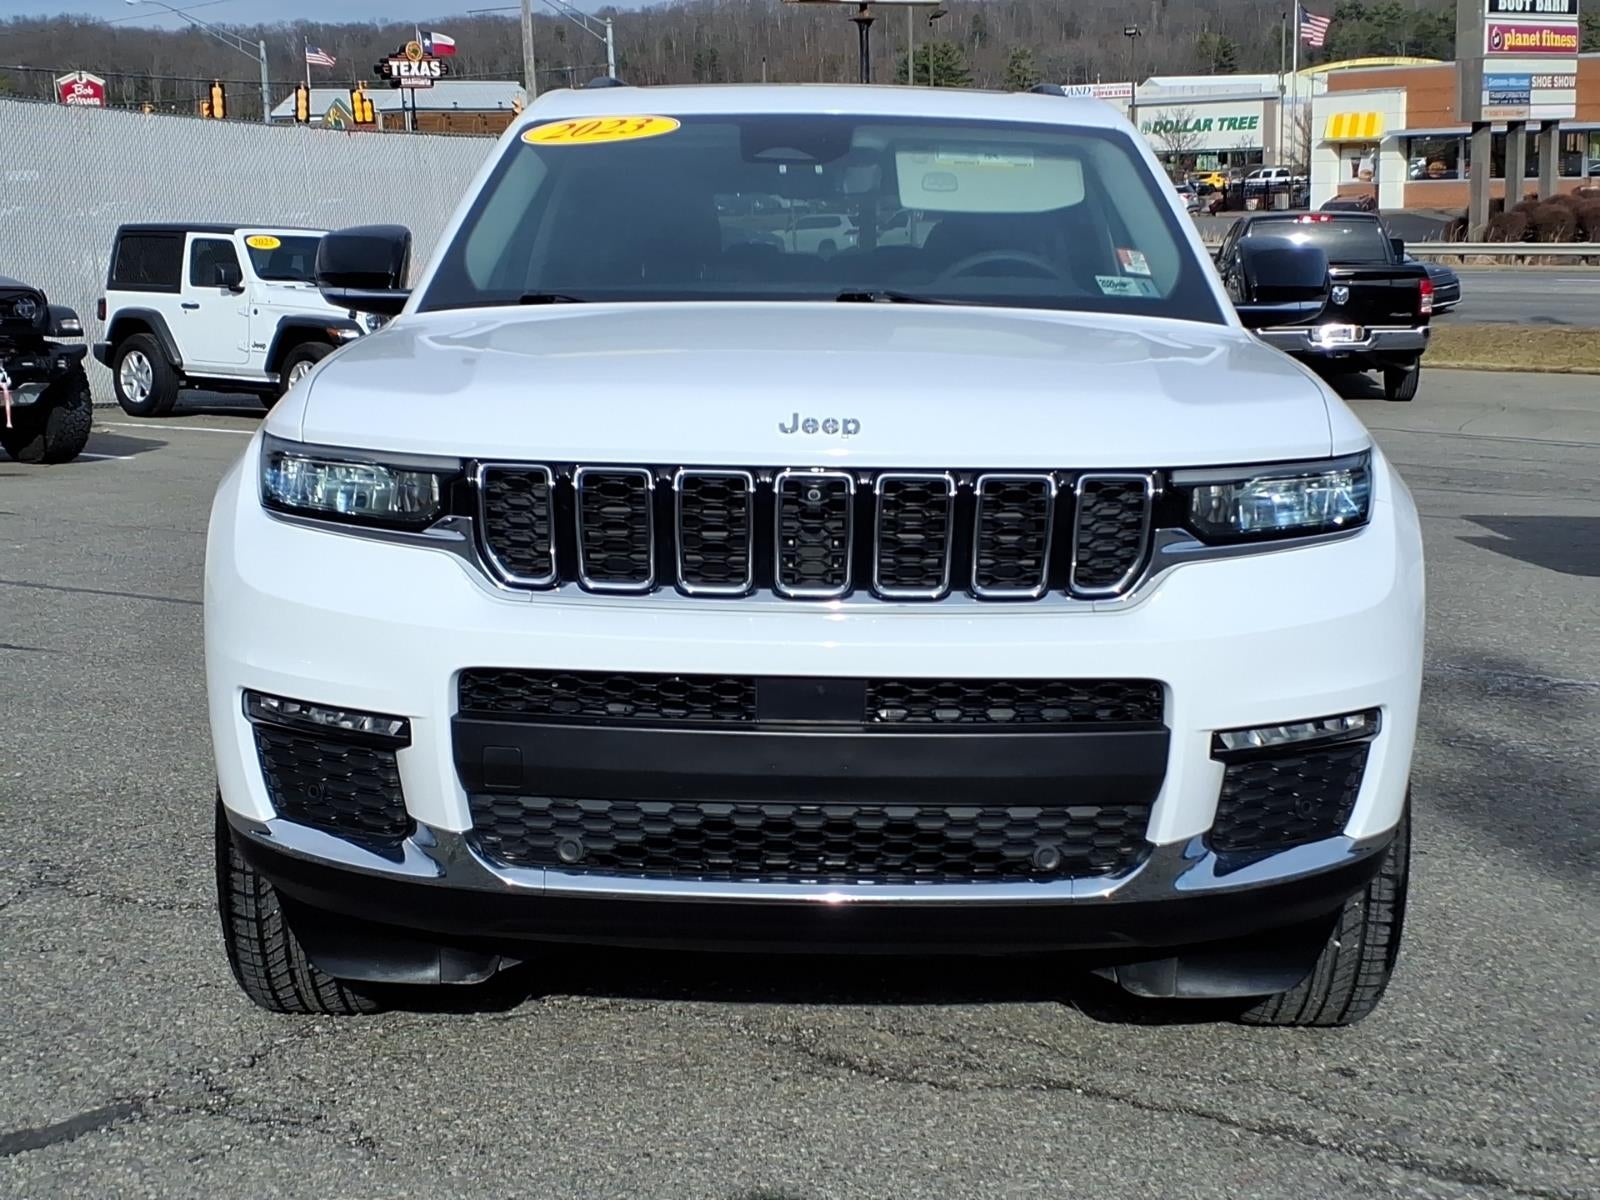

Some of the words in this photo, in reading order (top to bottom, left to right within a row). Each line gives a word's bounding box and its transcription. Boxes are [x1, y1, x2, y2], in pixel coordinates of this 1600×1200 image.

[1504, 28, 1540, 50] planet
[1542, 29, 1577, 48] fitness
[389, 60, 441, 77] TEXAS
[72, 84, 94, 95] Bob
[1531, 76, 1553, 89] SHOE
[1554, 76, 1576, 89] SHOW
[544, 117, 654, 140] 2023
[1151, 118, 1213, 134] DOLLAR
[1217, 116, 1259, 131] TREE
[778, 412, 861, 439] Jeep
